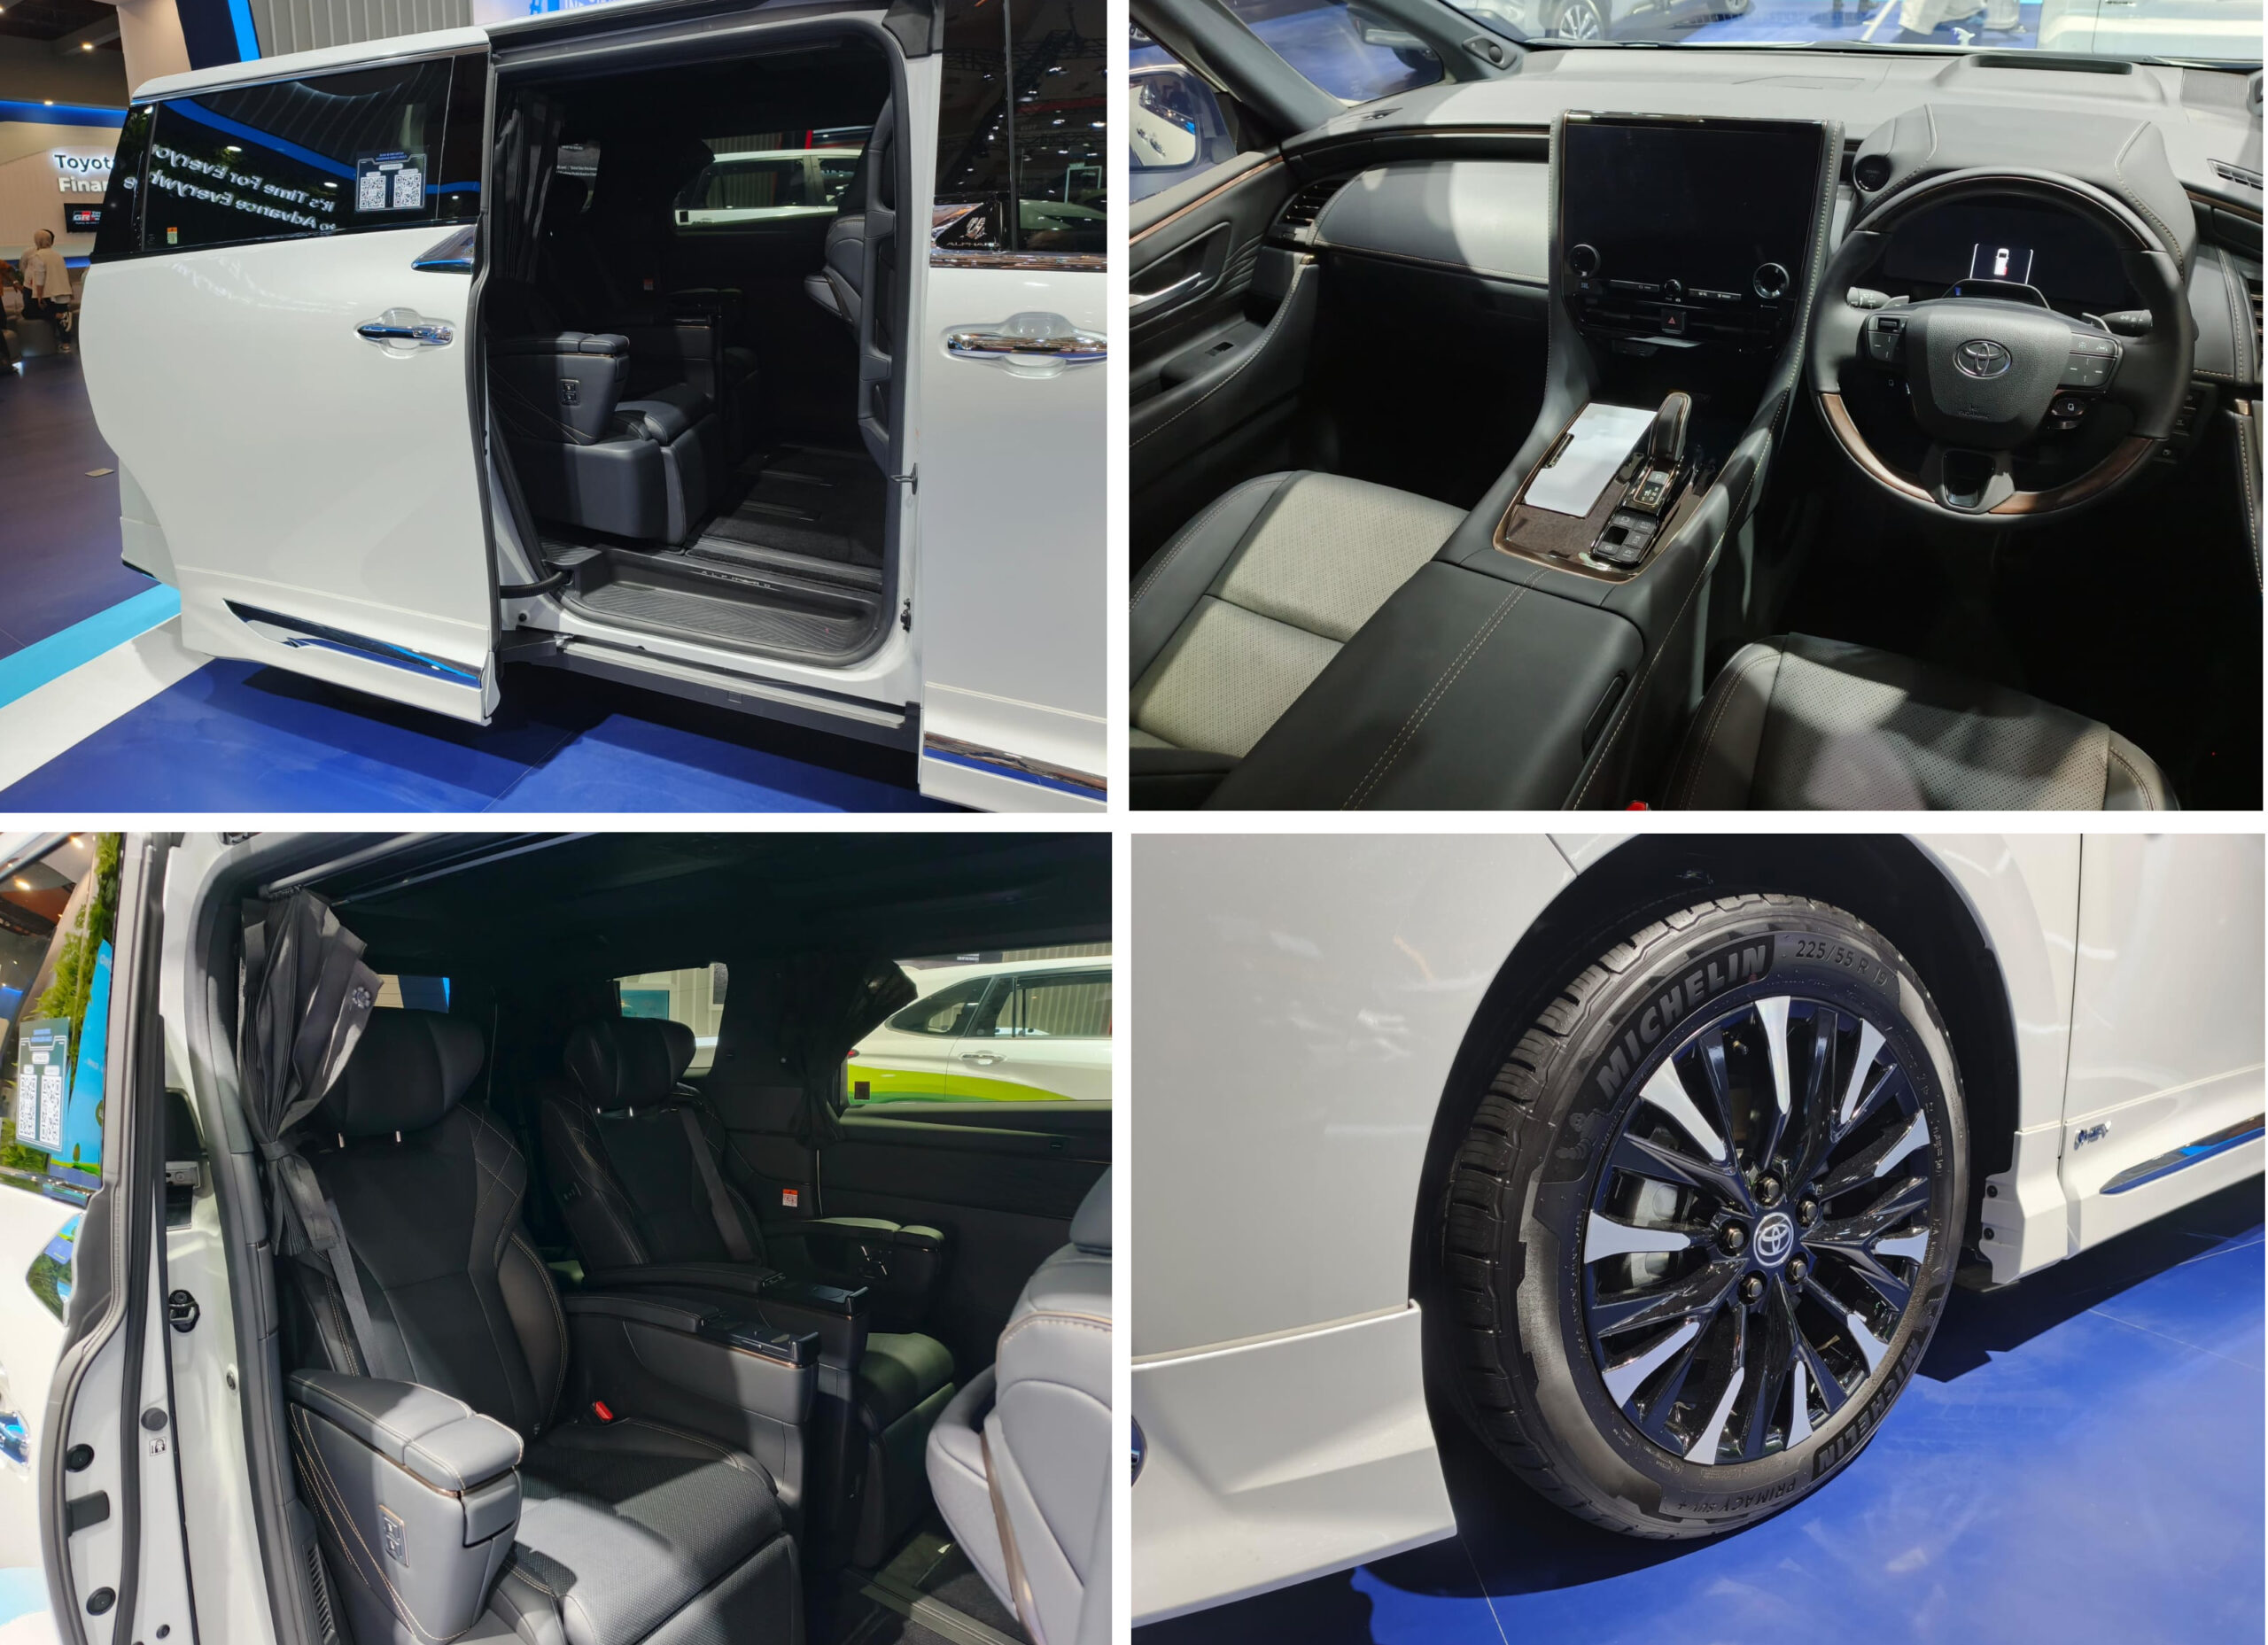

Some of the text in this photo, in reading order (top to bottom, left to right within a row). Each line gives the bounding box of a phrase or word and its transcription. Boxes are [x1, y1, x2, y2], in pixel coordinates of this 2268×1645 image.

[54, 154, 115, 172] Toyot
[1596, 945, 1766, 1099] MICHELIN
[1795, 940, 1853, 967] 225/55
[1858, 958, 1869, 974] R
[1818, 1338, 1921, 1473] MICHELIN
[1719, 1477, 1797, 1511] PRIMACY
